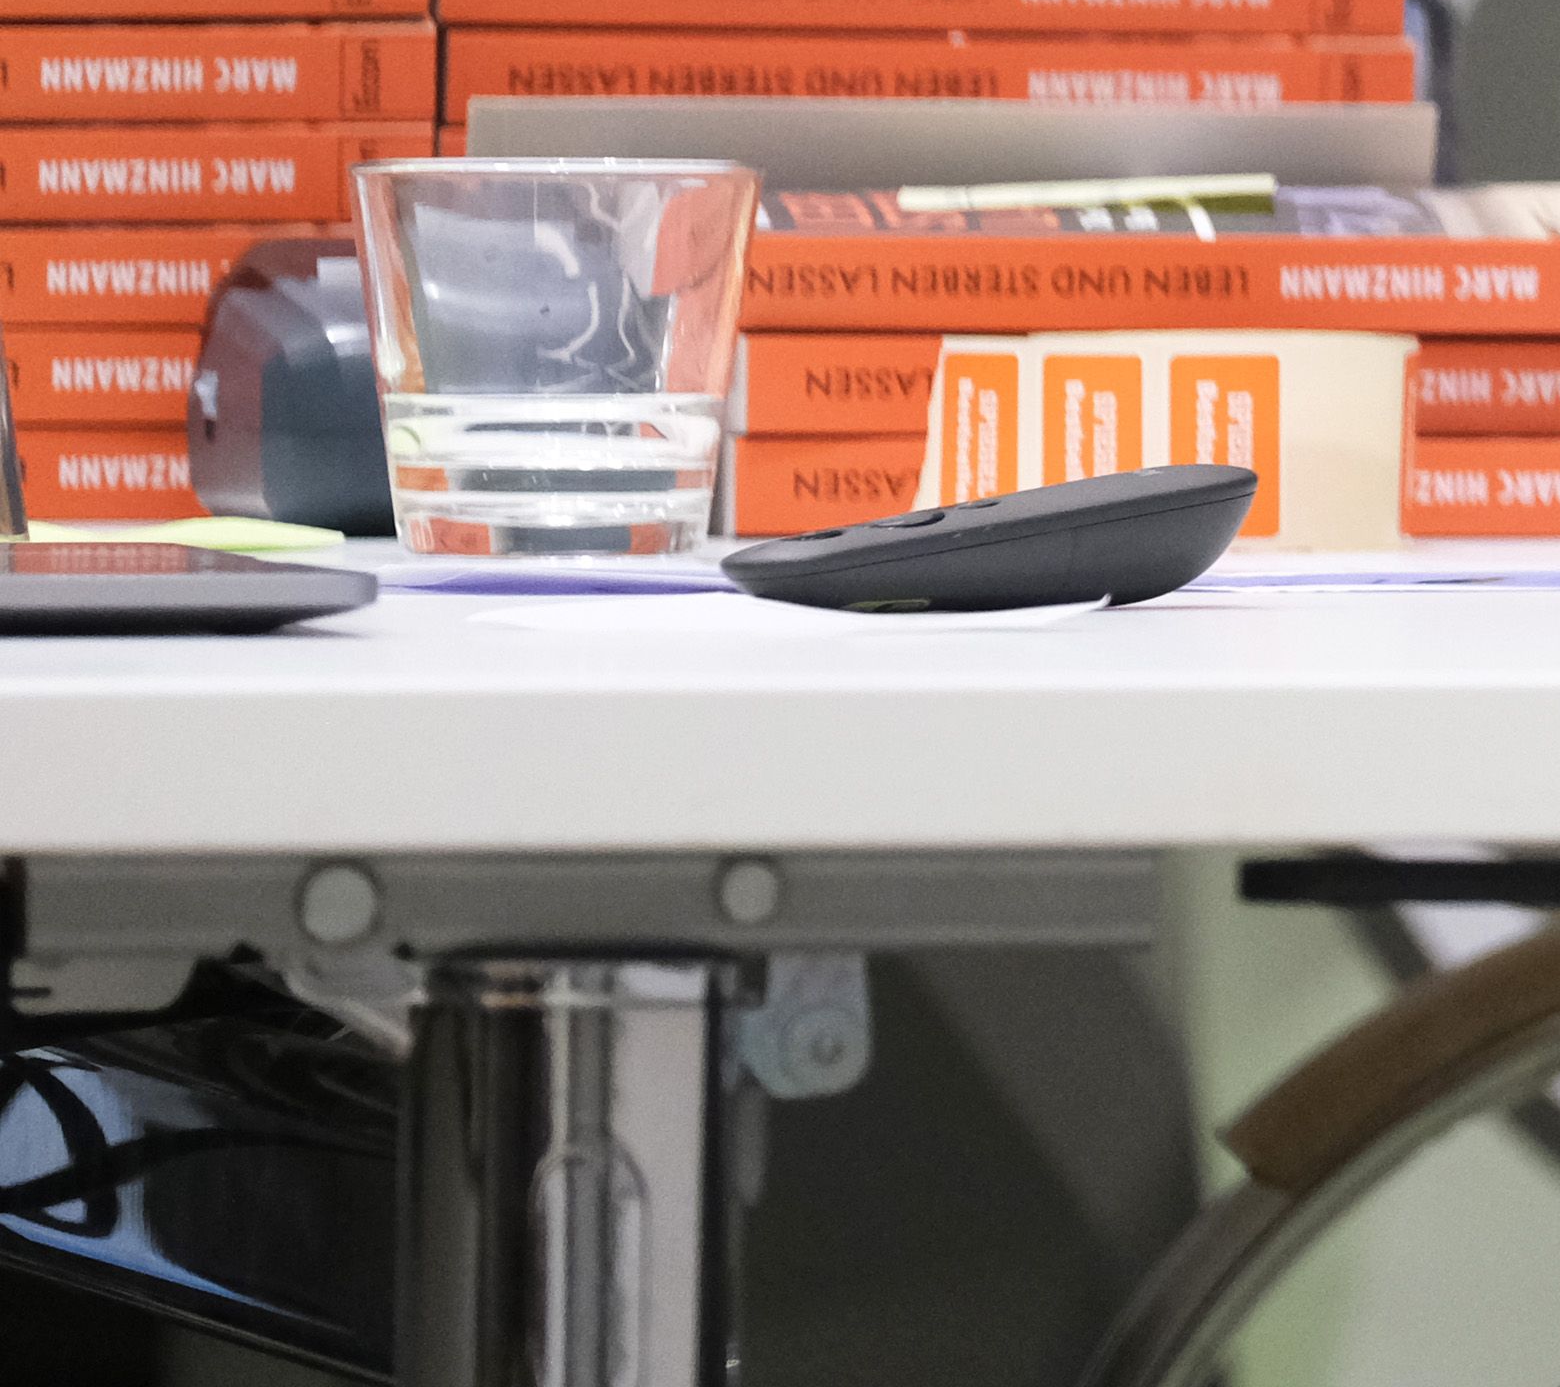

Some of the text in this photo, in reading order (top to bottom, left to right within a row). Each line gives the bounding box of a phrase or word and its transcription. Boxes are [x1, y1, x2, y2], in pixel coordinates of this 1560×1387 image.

[39, 56, 298, 94] MARC HINZMANN
[38, 157, 296, 195] MARC HINZMANN
[46, 259, 211, 295] HINZMANN
[746, 262, 879, 299] LASSEN
[1050, 263, 1132, 300] UND
[1143, 263, 1251, 300] LEBEN
[50, 357, 194, 392] INZMANN
[58, 453, 190, 489] NZMANN
